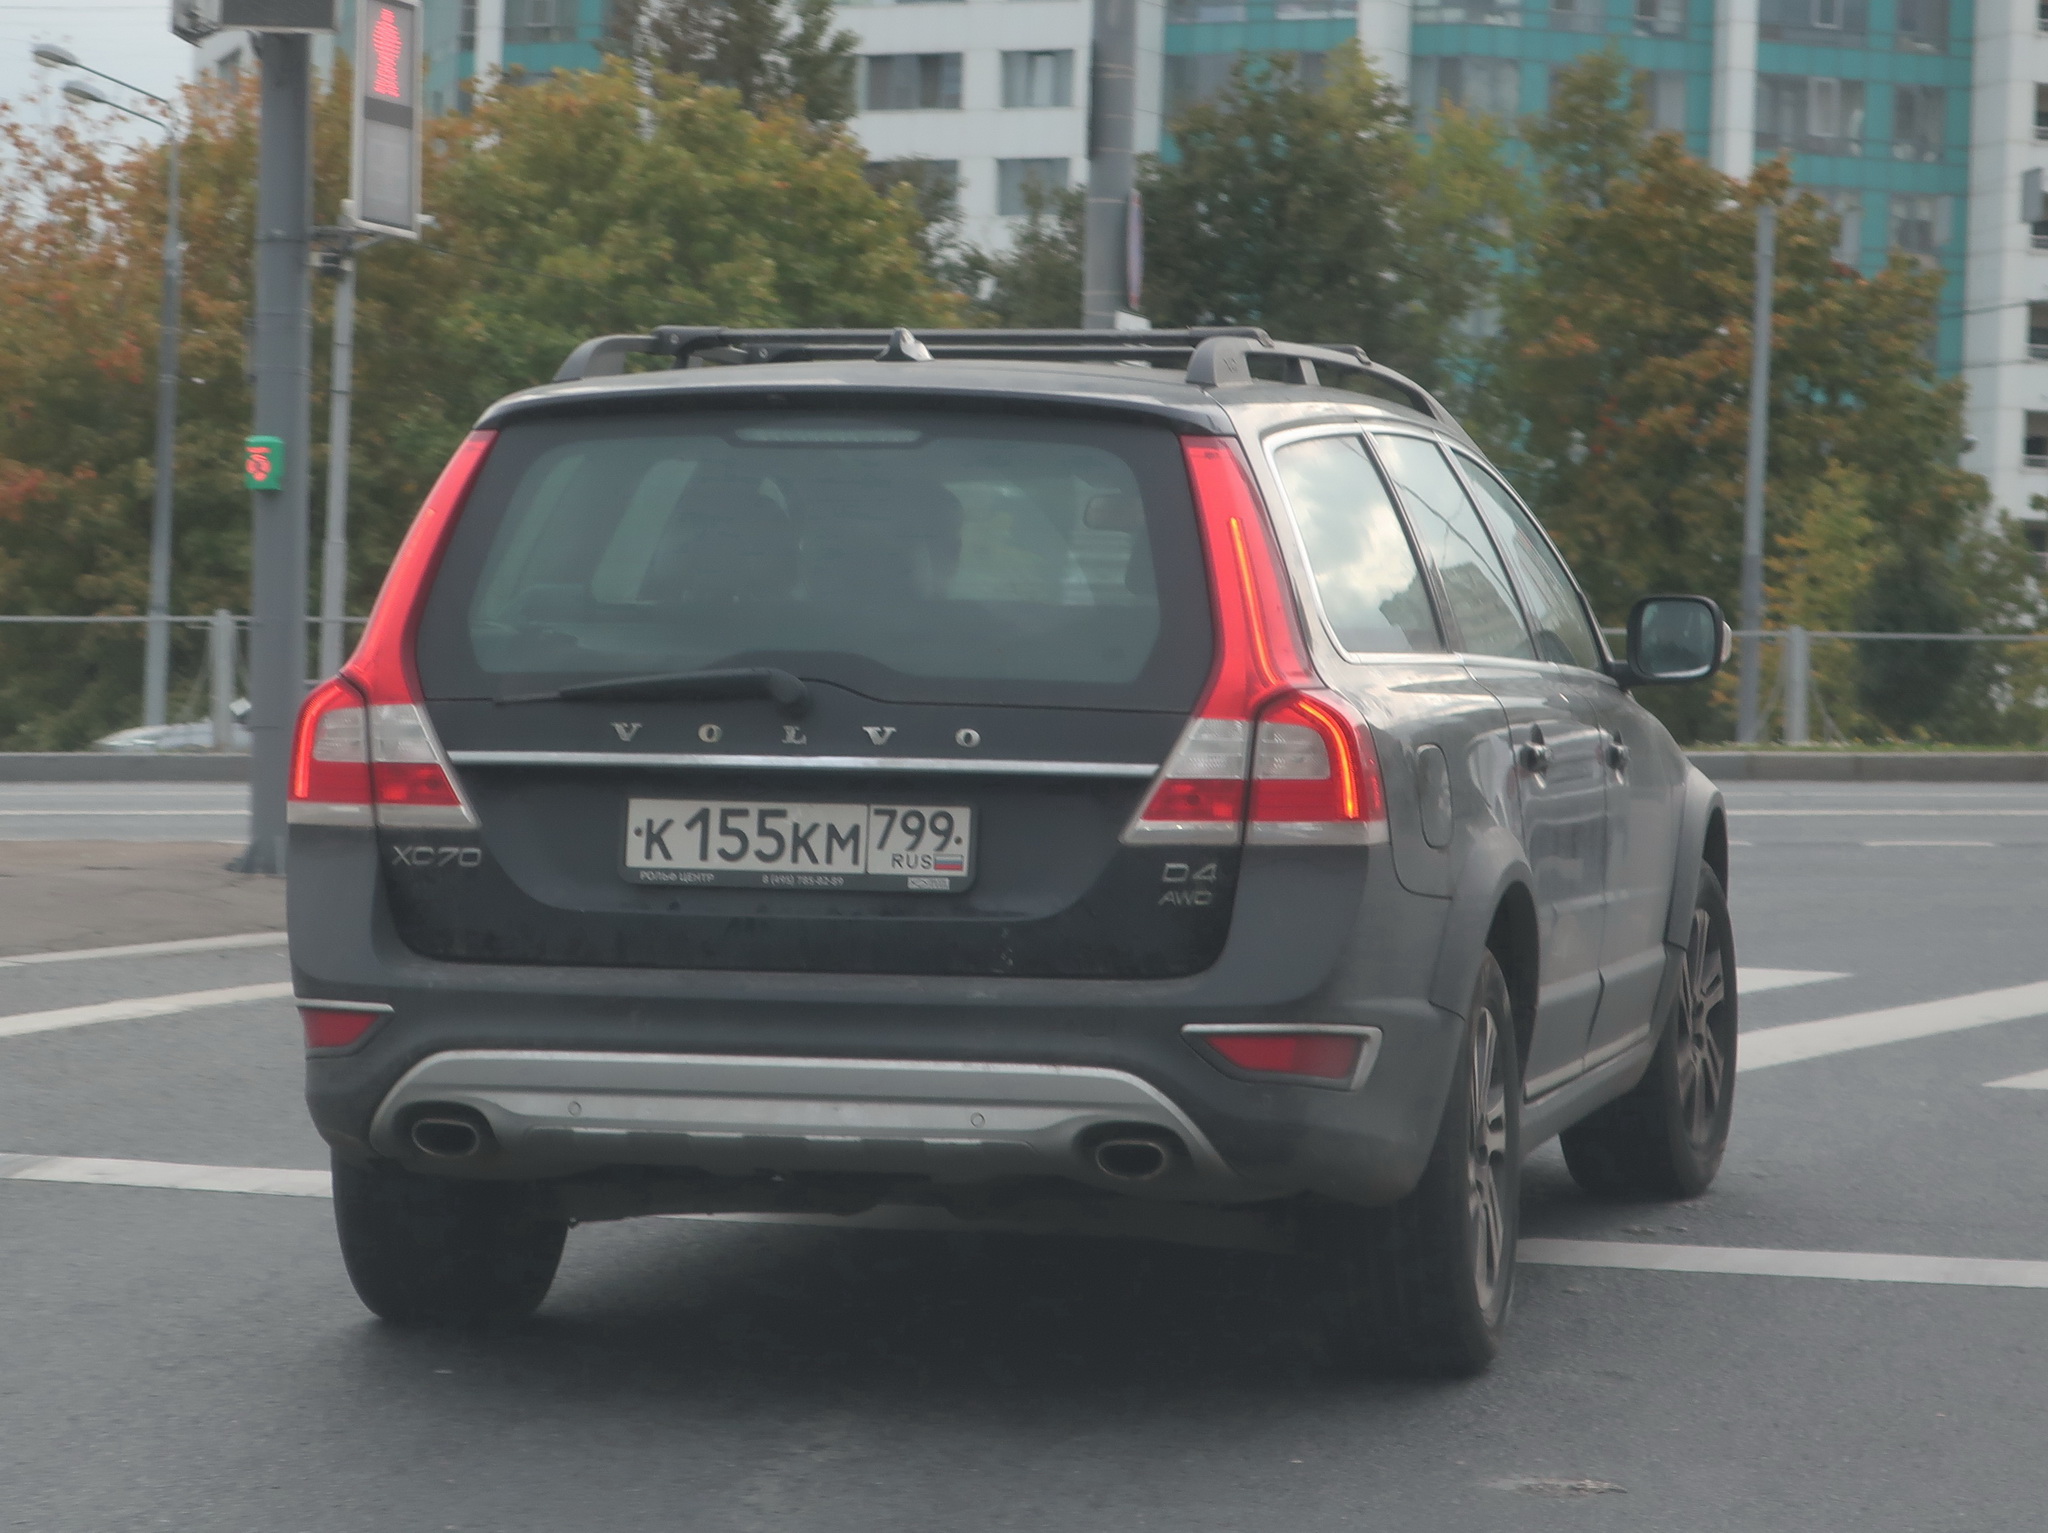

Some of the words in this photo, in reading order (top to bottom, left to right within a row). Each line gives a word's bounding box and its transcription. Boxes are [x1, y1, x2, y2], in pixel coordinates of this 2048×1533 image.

[611, 721, 981, 748] VOLVO
[873, 808, 954, 851] 799
[392, 845, 482, 868] XC70
[891, 853, 932, 870] RUS
[1158, 890, 1213, 906] AWD
